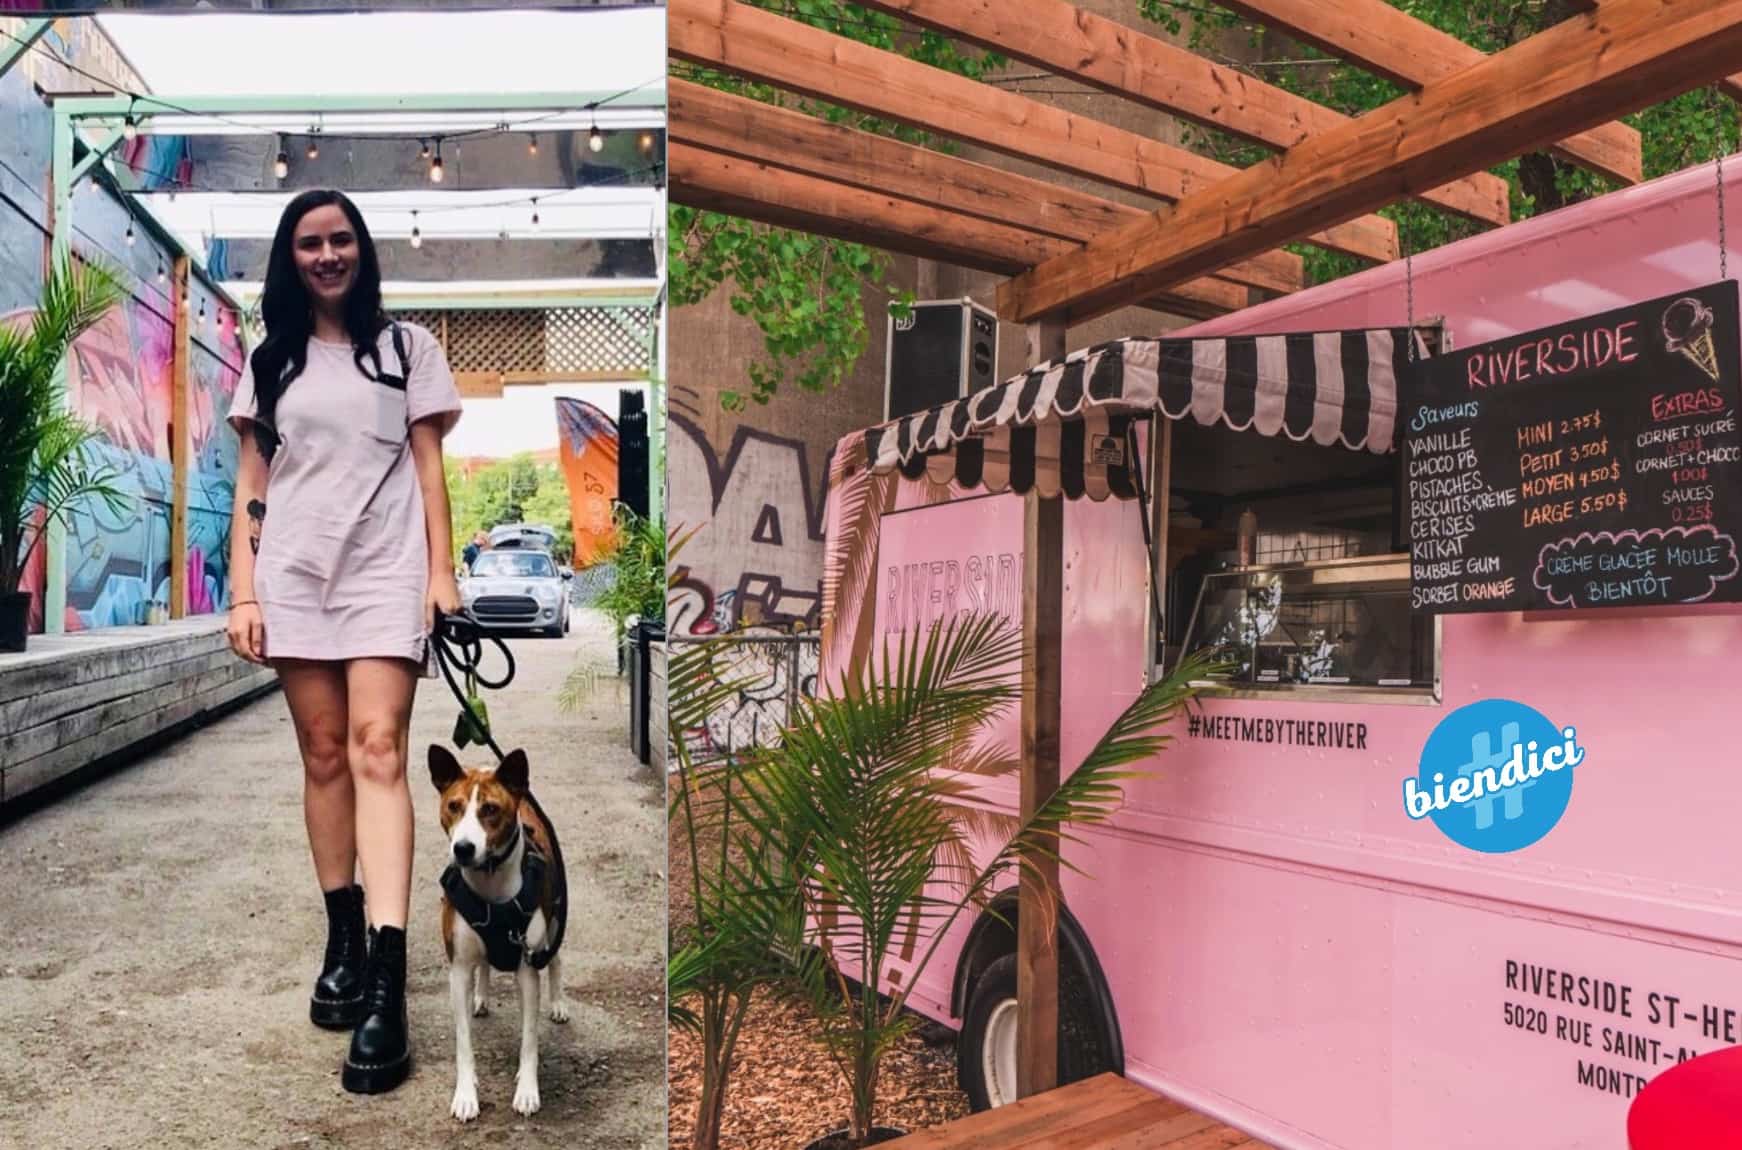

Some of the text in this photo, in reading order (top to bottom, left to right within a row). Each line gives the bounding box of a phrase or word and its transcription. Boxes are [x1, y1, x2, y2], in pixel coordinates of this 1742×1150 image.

[1467, 321, 1639, 389] RIVERSIDE
[1411, 401, 1479, 431] Saveurs
[1651, 388, 1724, 419] EXTRAS
[1409, 428, 1471, 457] VANILLE
[1517, 409, 1601, 448] MINI 2.75$
[1636, 410, 1736, 448] CORNET SUCRÉ
[1410, 449, 1478, 477] CHOCO PB
[1520, 435, 1608, 477] PETIT 3.50$
[584, 471, 605, 496] 57
[1410, 471, 1483, 499] PISTACHES
[1522, 457, 1620, 499] MOYEN 4.50$
[1524, 488, 1627, 528] LARGE 5.50$
[1662, 484, 1714, 505] SAUCES
[1410, 514, 1475, 539] CERISES
[1413, 534, 1469, 560] KITKAT
[1668, 545, 1721, 567] MOLLE
[1413, 556, 1500, 580] BUBBLE GUM
[886, 552, 1025, 634] RIVERSID
[1413, 577, 1515, 609] SORBET ORANGE
[1585, 569, 1672, 601] BIENTÔT
[1187, 714, 1368, 750] #MEETMEBYTHERIVER
[1505, 959, 1742, 1044] RIVERSIDE ST-HE
[1504, 1002, 1696, 1065] 5020 RUE SAINT-A
